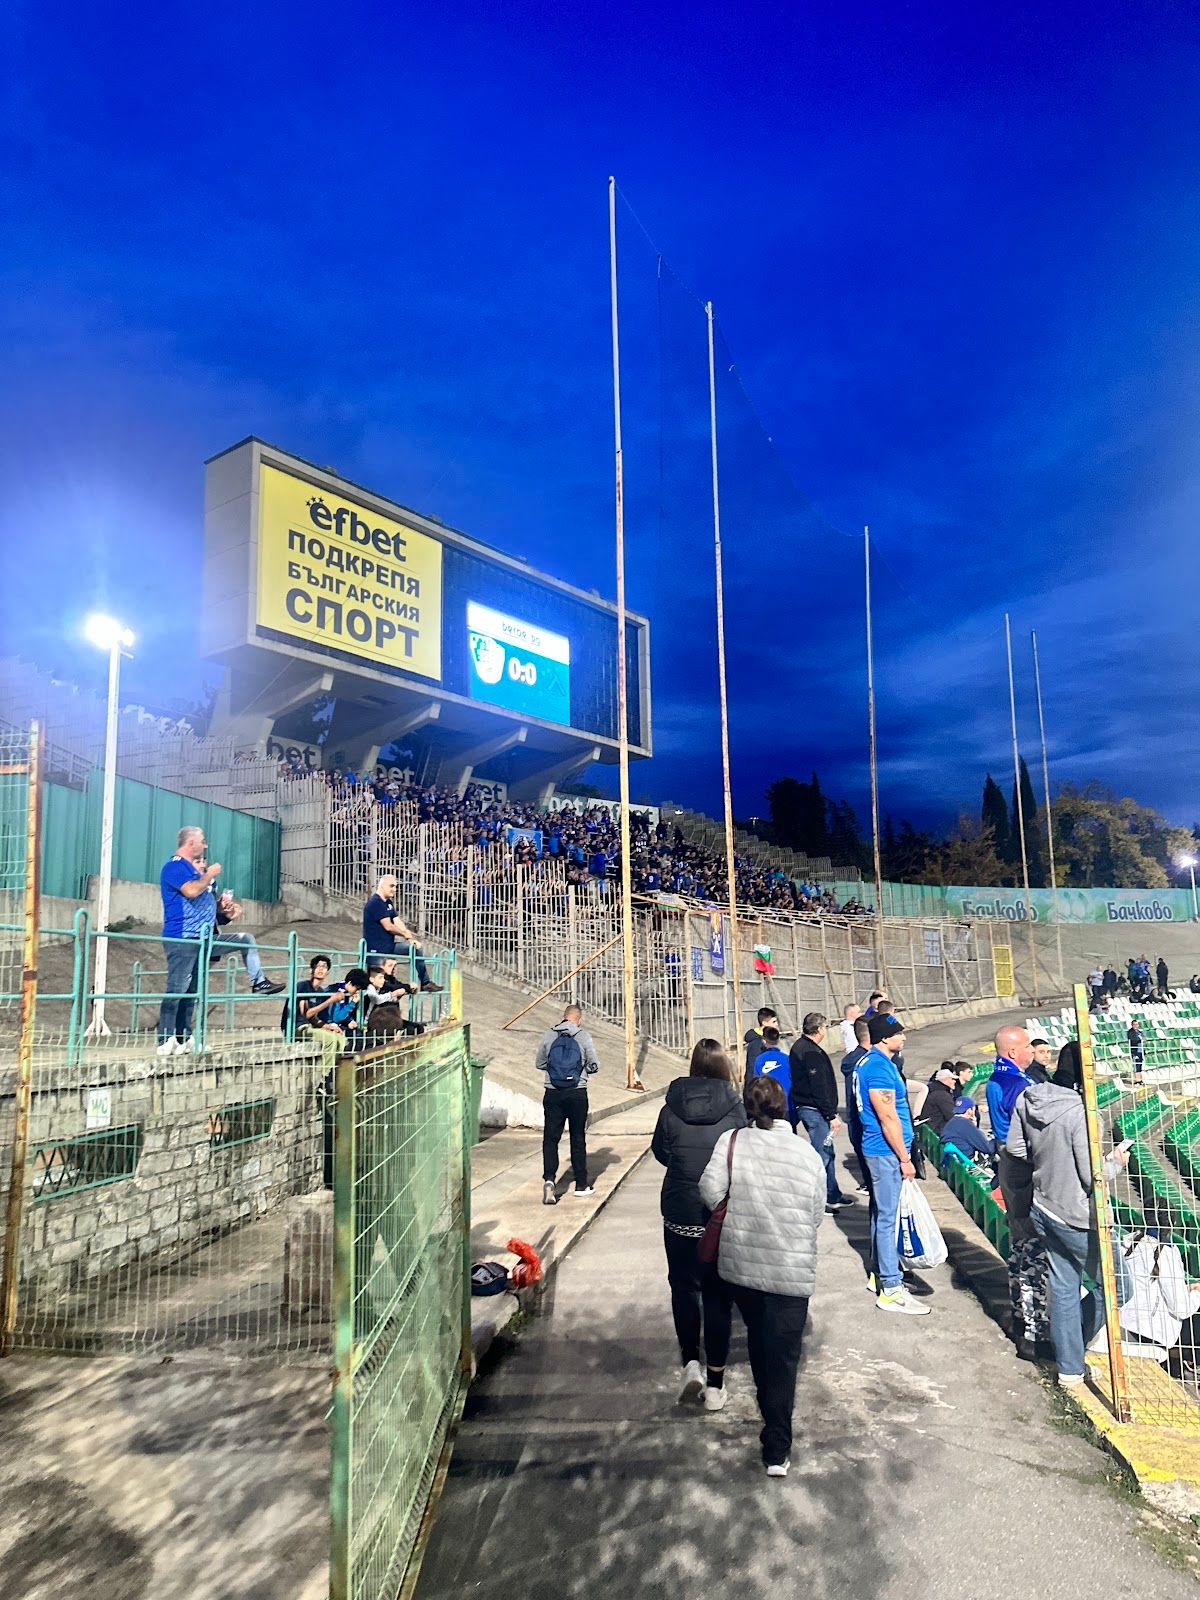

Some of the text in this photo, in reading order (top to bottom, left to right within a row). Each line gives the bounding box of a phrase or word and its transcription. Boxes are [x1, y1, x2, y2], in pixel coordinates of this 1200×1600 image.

[309, 501, 407, 562] efbet
[288, 529, 420, 598] ПОДКРЕПЯ
[288, 561, 420, 623] БЪЛГАРСКИЯ
[286, 588, 420, 657] СПОРТ
[508, 656, 537, 686] 0:0
[1107, 900, 1172, 920] Бачково
